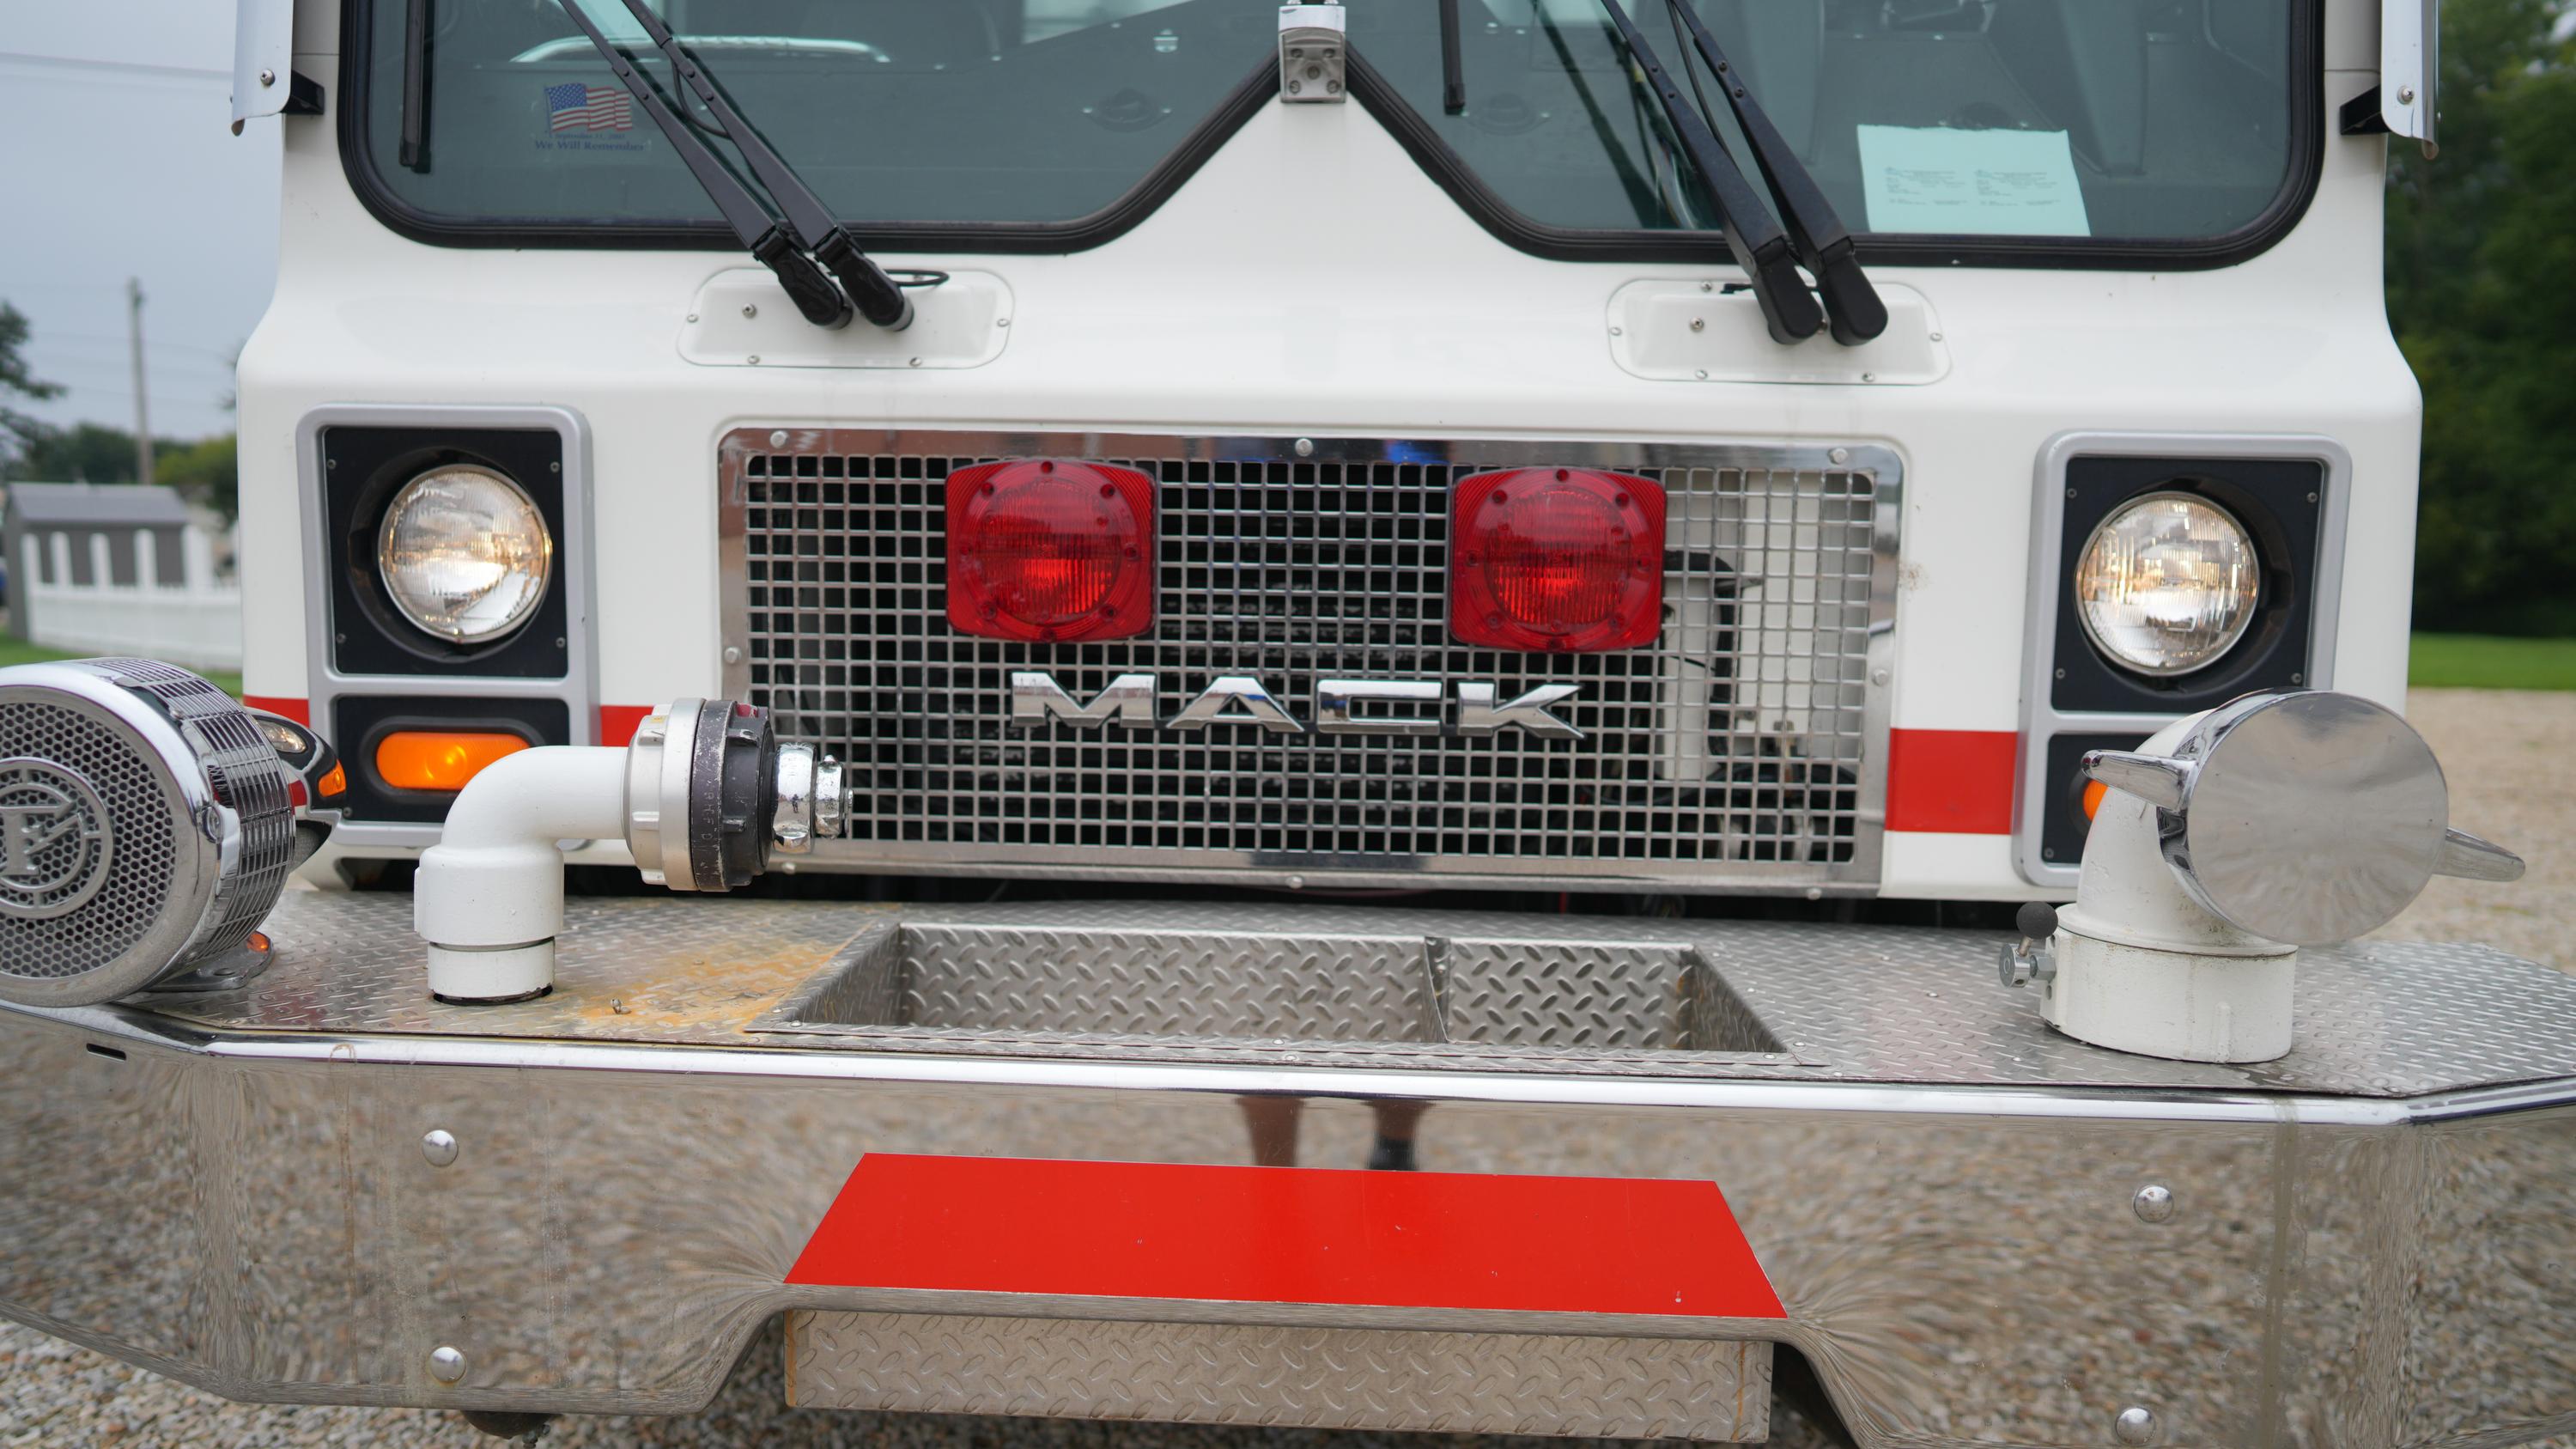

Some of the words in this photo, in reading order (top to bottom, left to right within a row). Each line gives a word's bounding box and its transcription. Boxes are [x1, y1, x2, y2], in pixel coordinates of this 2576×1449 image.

[535, 140, 553, 150] We
[557, 140, 580, 150] Will
[584, 140, 645, 151] Remember
[1010, 671, 1587, 740] MACK
